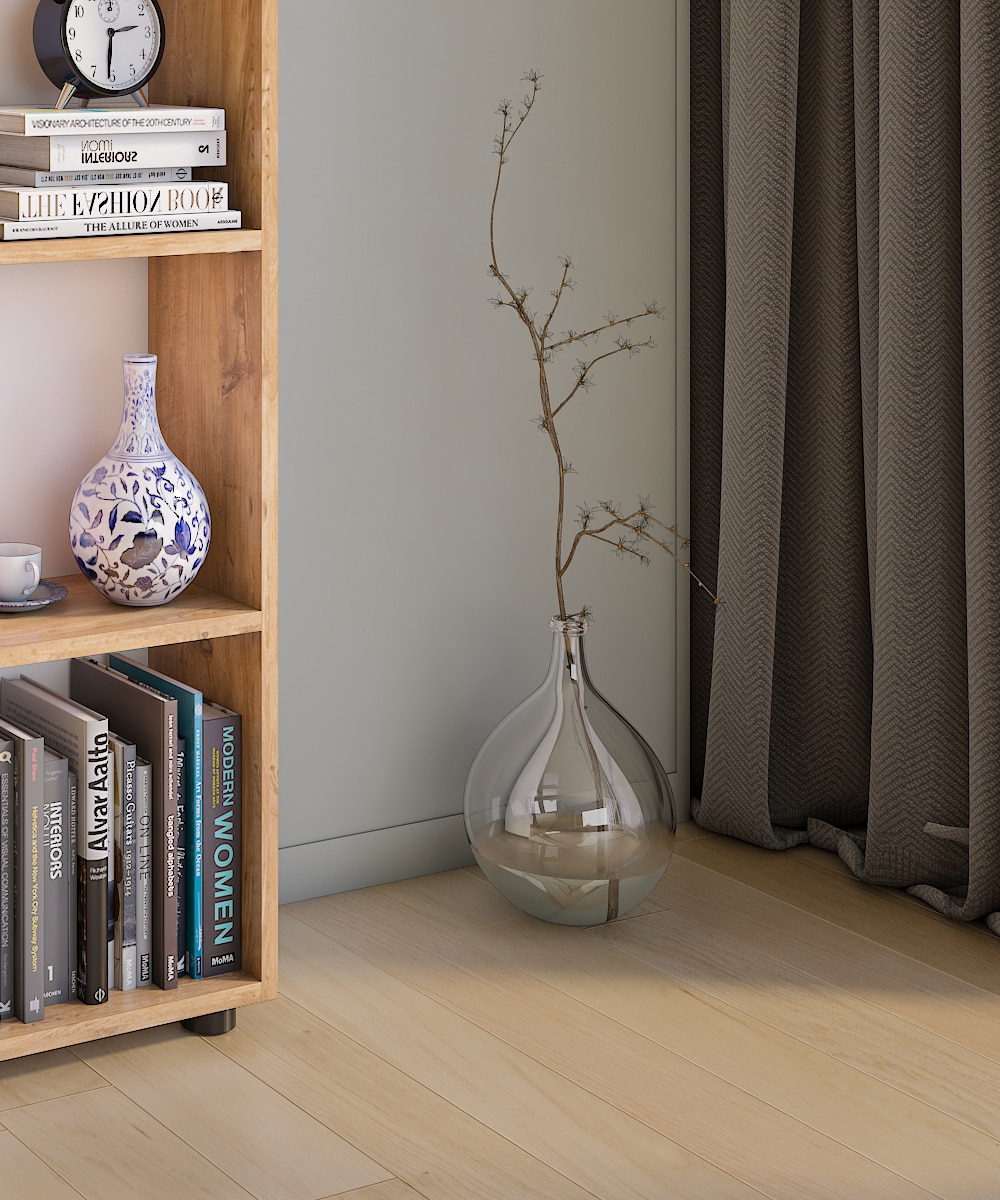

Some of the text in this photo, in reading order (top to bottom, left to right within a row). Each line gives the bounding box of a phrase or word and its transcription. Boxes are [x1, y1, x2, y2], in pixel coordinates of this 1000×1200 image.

[74, 4, 85, 18] 10
[137, 4, 145, 16] 2
[68, 27, 76, 41] 9
[144, 26, 151, 39] 3
[75, 49, 83, 62] 8
[139, 48, 147, 60] 4
[91, 65, 98, 78] 7
[129, 63, 136, 76] 5
[31, 119, 69, 129] VISIONARY
[70, 118, 121, 128] ARCHITECTURE
[122, 118, 132, 128] OF
[132, 118, 145, 127] THE
[146, 118, 163, 127] 20TH
[163, 117, 193, 127] CENTURY
[84, 218, 199, 233] THE ALLURE OF WOMEN
[1, 773, 9, 825] ESSENTIALS
[87, 732, 110, 852] Alvar Aalto
[125, 760, 136, 846] Picasso Guitars
[1, 827, 9, 839] OF
[140, 815, 150, 839] ON
[213, 726, 235, 946] MODERN WOMEN
[49, 800, 63, 880] INTERIORS
[1, 840, 9, 871] VISUAL
[140, 845, 150, 881] LINE
[166, 815, 175, 897] tangled alphabets
[1, 872, 9, 948] COMMUNICATION
[31, 901, 39, 915] City
[31, 916, 39, 945] Subway
[31, 946, 39, 972] System
[140, 954, 149, 981] MoMA
[167, 955, 175, 981] MoMA
[211, 953, 234, 967] MoMA
[47, 965, 54, 982] 1
